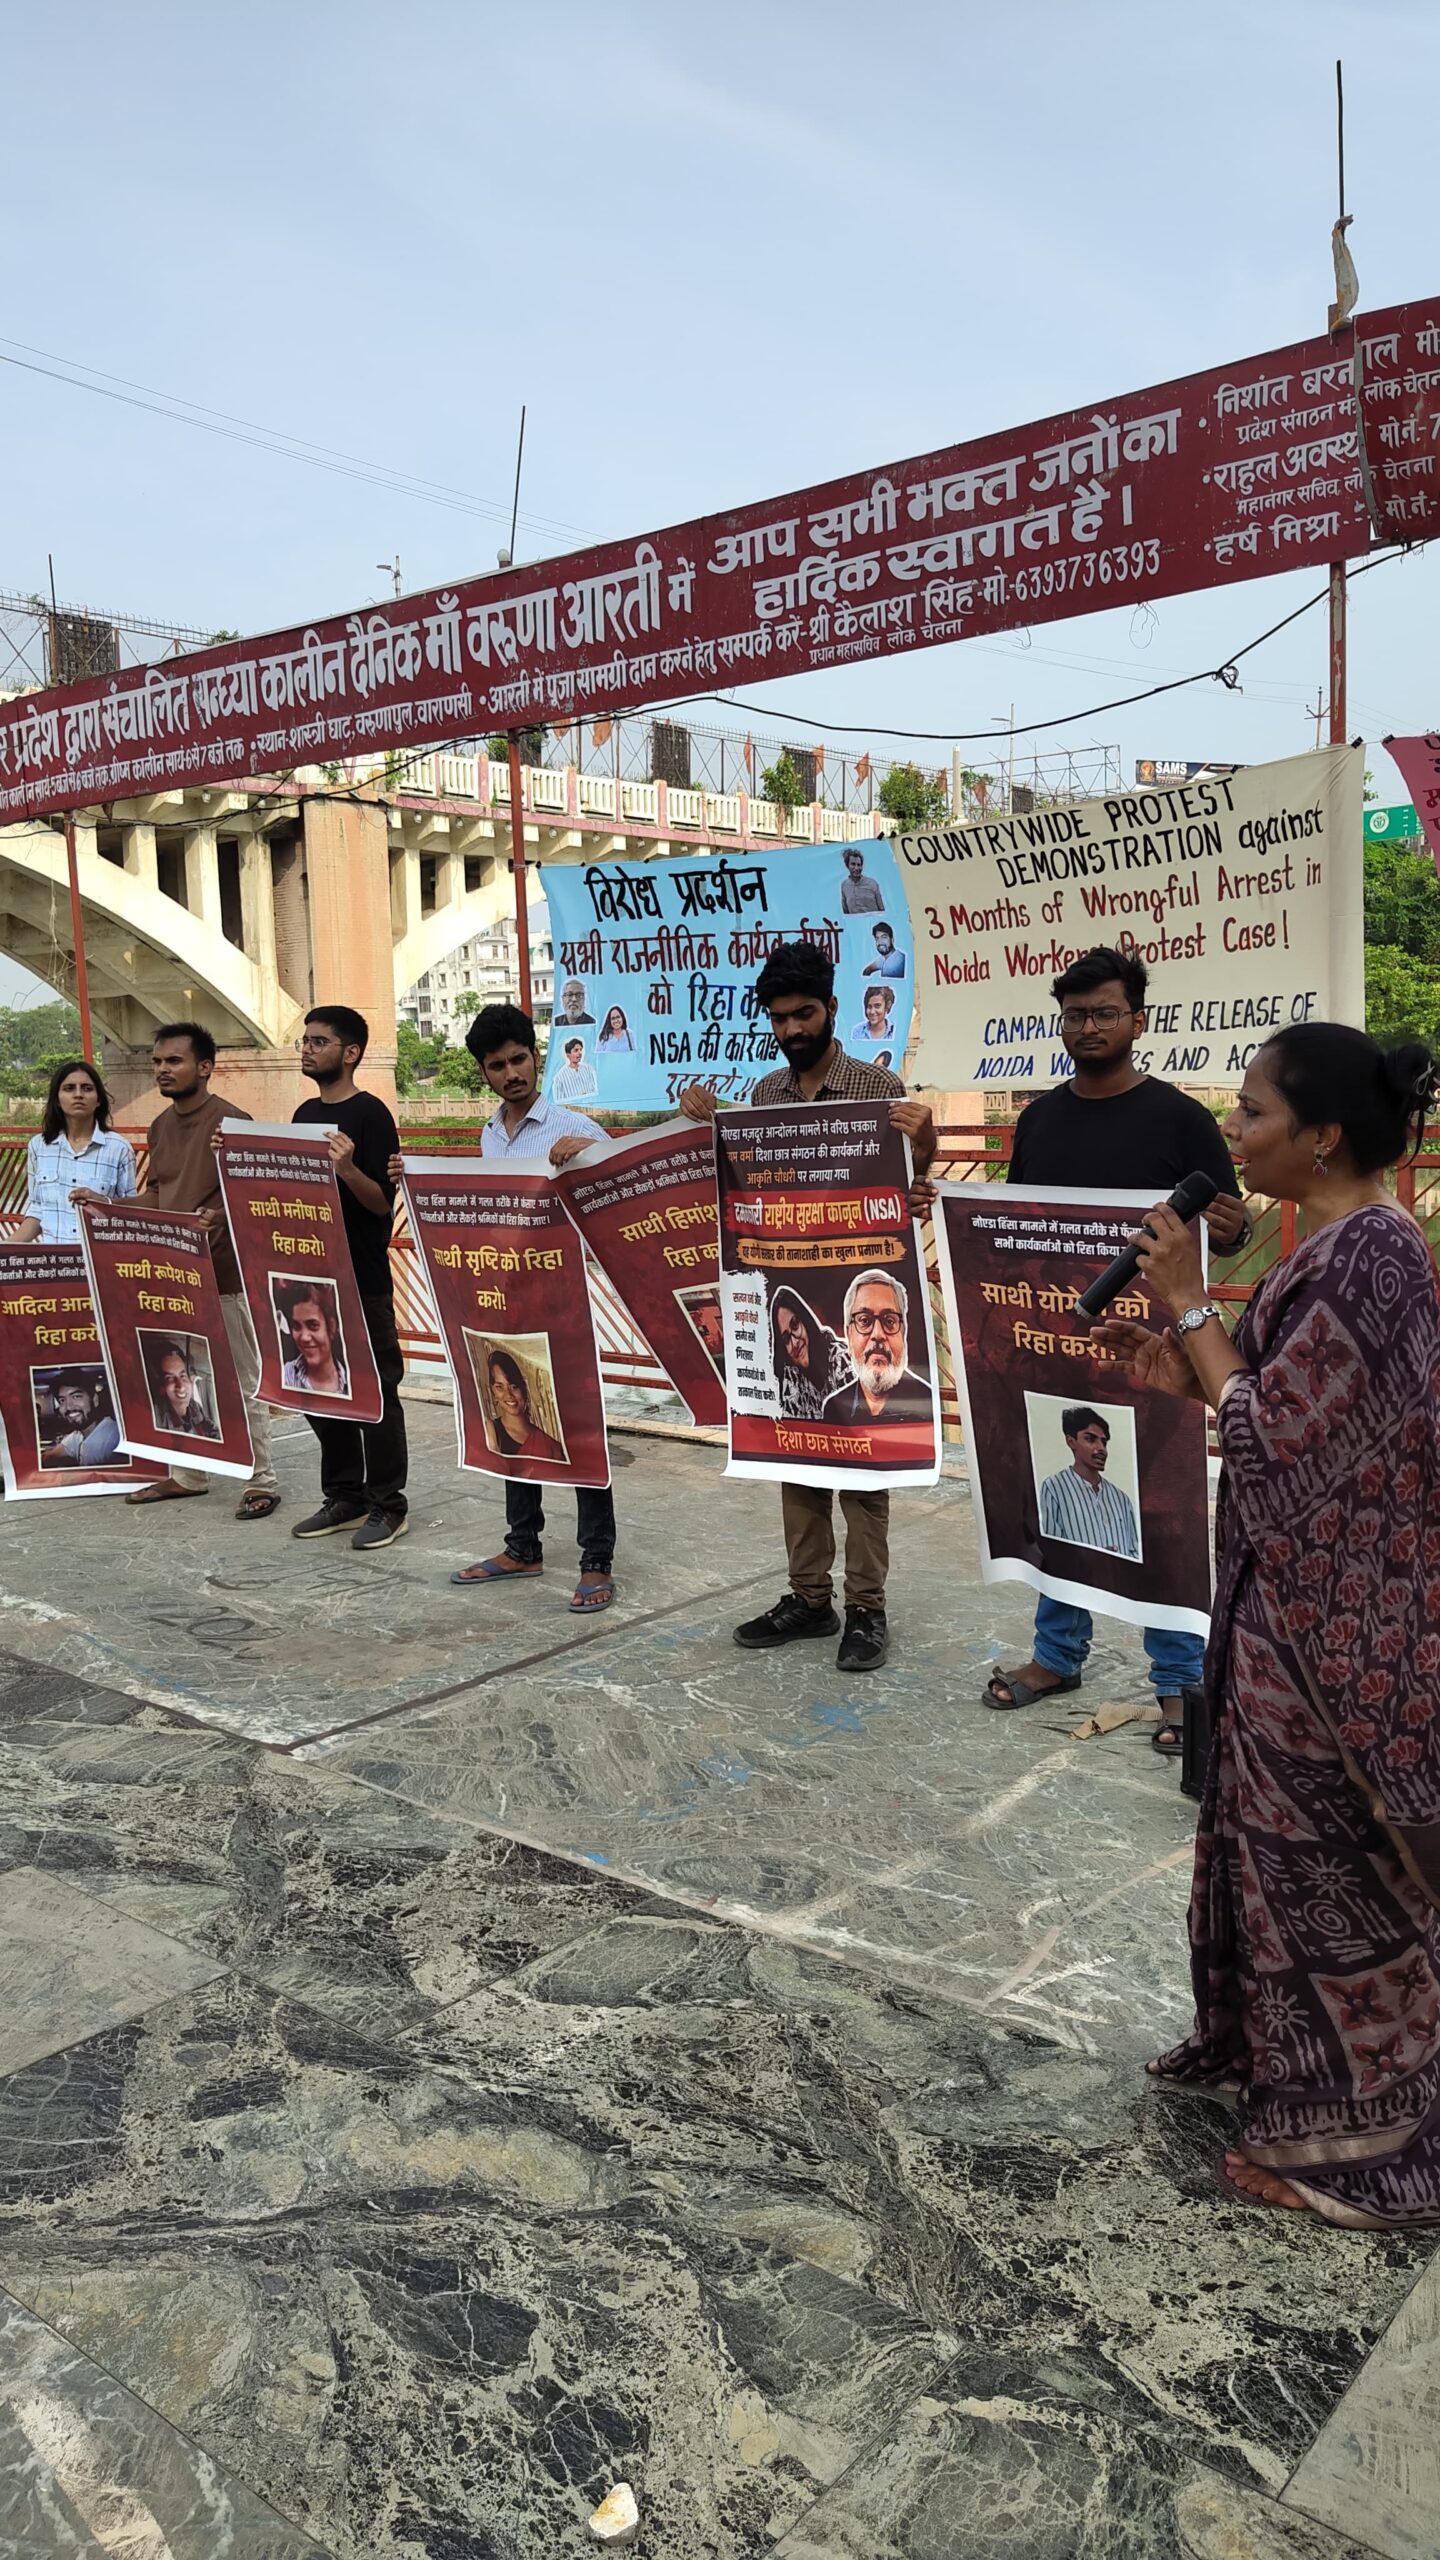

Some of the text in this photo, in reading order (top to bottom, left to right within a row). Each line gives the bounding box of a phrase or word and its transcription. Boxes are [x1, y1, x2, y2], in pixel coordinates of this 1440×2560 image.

[1214, 374, 1295, 418] निशांत
[1236, 376, 1402, 445] प्रदेश संगठन लोक
[1214, 451, 1279, 494] राहुल
[1297, 456, 1436, 503] सचिव चेतना
[707, 518, 800, 574] आप
[807, 478, 901, 548] सभी
[906, 455, 1026, 521] भक्त
[1214, 511, 1340, 565] हर्ष मिश्रा
[752, 550, 881, 619] हार्दिक
[885, 502, 1067, 580] स्वागत
[10, 704, 60, 772] प्रदेश
[61, 699, 101, 765] द्वारा
[102, 668, 190, 749] संचालित
[259, 628, 347, 711] कालीन
[346, 614, 423, 699] दैनिक
[423, 591, 463, 675] माँ
[560, 541, 663, 649] आरती
[668, 556, 697, 614] में
[809, 618, 964, 665] प्रधान महासचिव लोक चेतना
[132, 747, 165, 782] कालीन
[225, 738, 244, 765] तक
[487, 669, 531, 714] आरती
[533, 667, 544, 699] में
[546, 671, 576, 706] पूजा
[577, 649, 629, 699] सामग्री
[629, 653, 659, 688] दान
[659, 638, 693, 678] करने
[694, 635, 716, 680] हेतु
[717, 620, 775, 667] सम्पर्क
[833, 592, 917, 636] कैलाश
[1155, 761, 1188, 775] SAMS
[901, 777, 1235, 867] COUNTRYWIDE PROTEST
[996, 799, 1324, 888] DEMONSTRATION against
[584, 858, 767, 922] विरोध प्रदर्शन
[924, 854, 1322, 940] 3 Months of Wrongful Arrest in
[560, 928, 607, 976] सभी
[609, 924, 719, 974] राजनीतिक
[934, 953, 992, 987] Noida
[1119, 922, 1207, 965] Protest
[648, 972, 737, 1022] को रिहा
[1143, 1003, 1183, 1033] THE
[1190, 995, 1284, 1032] RELEASE
[1291, 991, 1318, 1022] OF
[650, 1022, 723, 1065] NSA की
[973, 1046, 1210, 1080] NOIDA AND
[765, 1122, 798, 1139] आन्दोलन
[799, 1120, 821, 1136] मामले
[830, 1120, 849, 1134] वरिष्ठ
[851, 1120, 878, 1132] पत्रकार
[755, 1147, 773, 1162] दिशा
[774, 1149, 790, 1161] छात्र
[791, 1144, 815, 1160] संगठन
[817, 1142, 828, 1158] की
[830, 1140, 863, 1158] कार्यकर्ता
[864, 1139, 880, 1156] और
[746, 1167, 850, 1188] आकृति चौधरी पर लगाया गया
[249, 1197, 334, 1224] साथी मनीषा को
[618, 1211, 667, 1242] साथी
[764, 1196, 795, 1230] राष्ट्रीय
[796, 1201, 824, 1232] सुरक्षा
[825, 1200, 862, 1229] कानून
[863, 1194, 902, 1224] (NSA)
[971, 1215, 997, 1229] नोएडा
[997, 1216, 1018, 1231] हिंसा
[1019, 1219, 1047, 1233] मामले
[1049, 1219, 1058, 1233] में
[1083, 1222, 1107, 1237] तरीके
[1109, 1223, 1118, 1237] से
[272, 1231, 325, 1257] रिहा करो!
[432, 1244, 563, 1277] साथी सृष्टि को रिहा
[663, 1246, 701, 1268] रिहा
[776, 1245, 785, 1261] की
[786, 1244, 820, 1261] तानाशाही
[821, 1247, 833, 1259] का
[834, 1245, 856, 1262] खुला
[857, 1243, 883, 1257] प्रमाण
[994, 1237, 1120, 1257] सभी को रिहा किया
[115, 1259, 202, 1288] साथी रूपेश को
[1, 1295, 57, 1315] आदित्य
[137, 1291, 195, 1316] रिहा करो!
[476, 1285, 507, 1311] करो!
[980, 1281, 1151, 1320] साथी को
[34, 1325, 67, 1345] रिहा
[1013, 1322, 1055, 1356] रिहा
[775, 1425, 873, 1456] दिशा छात्र संगठन
